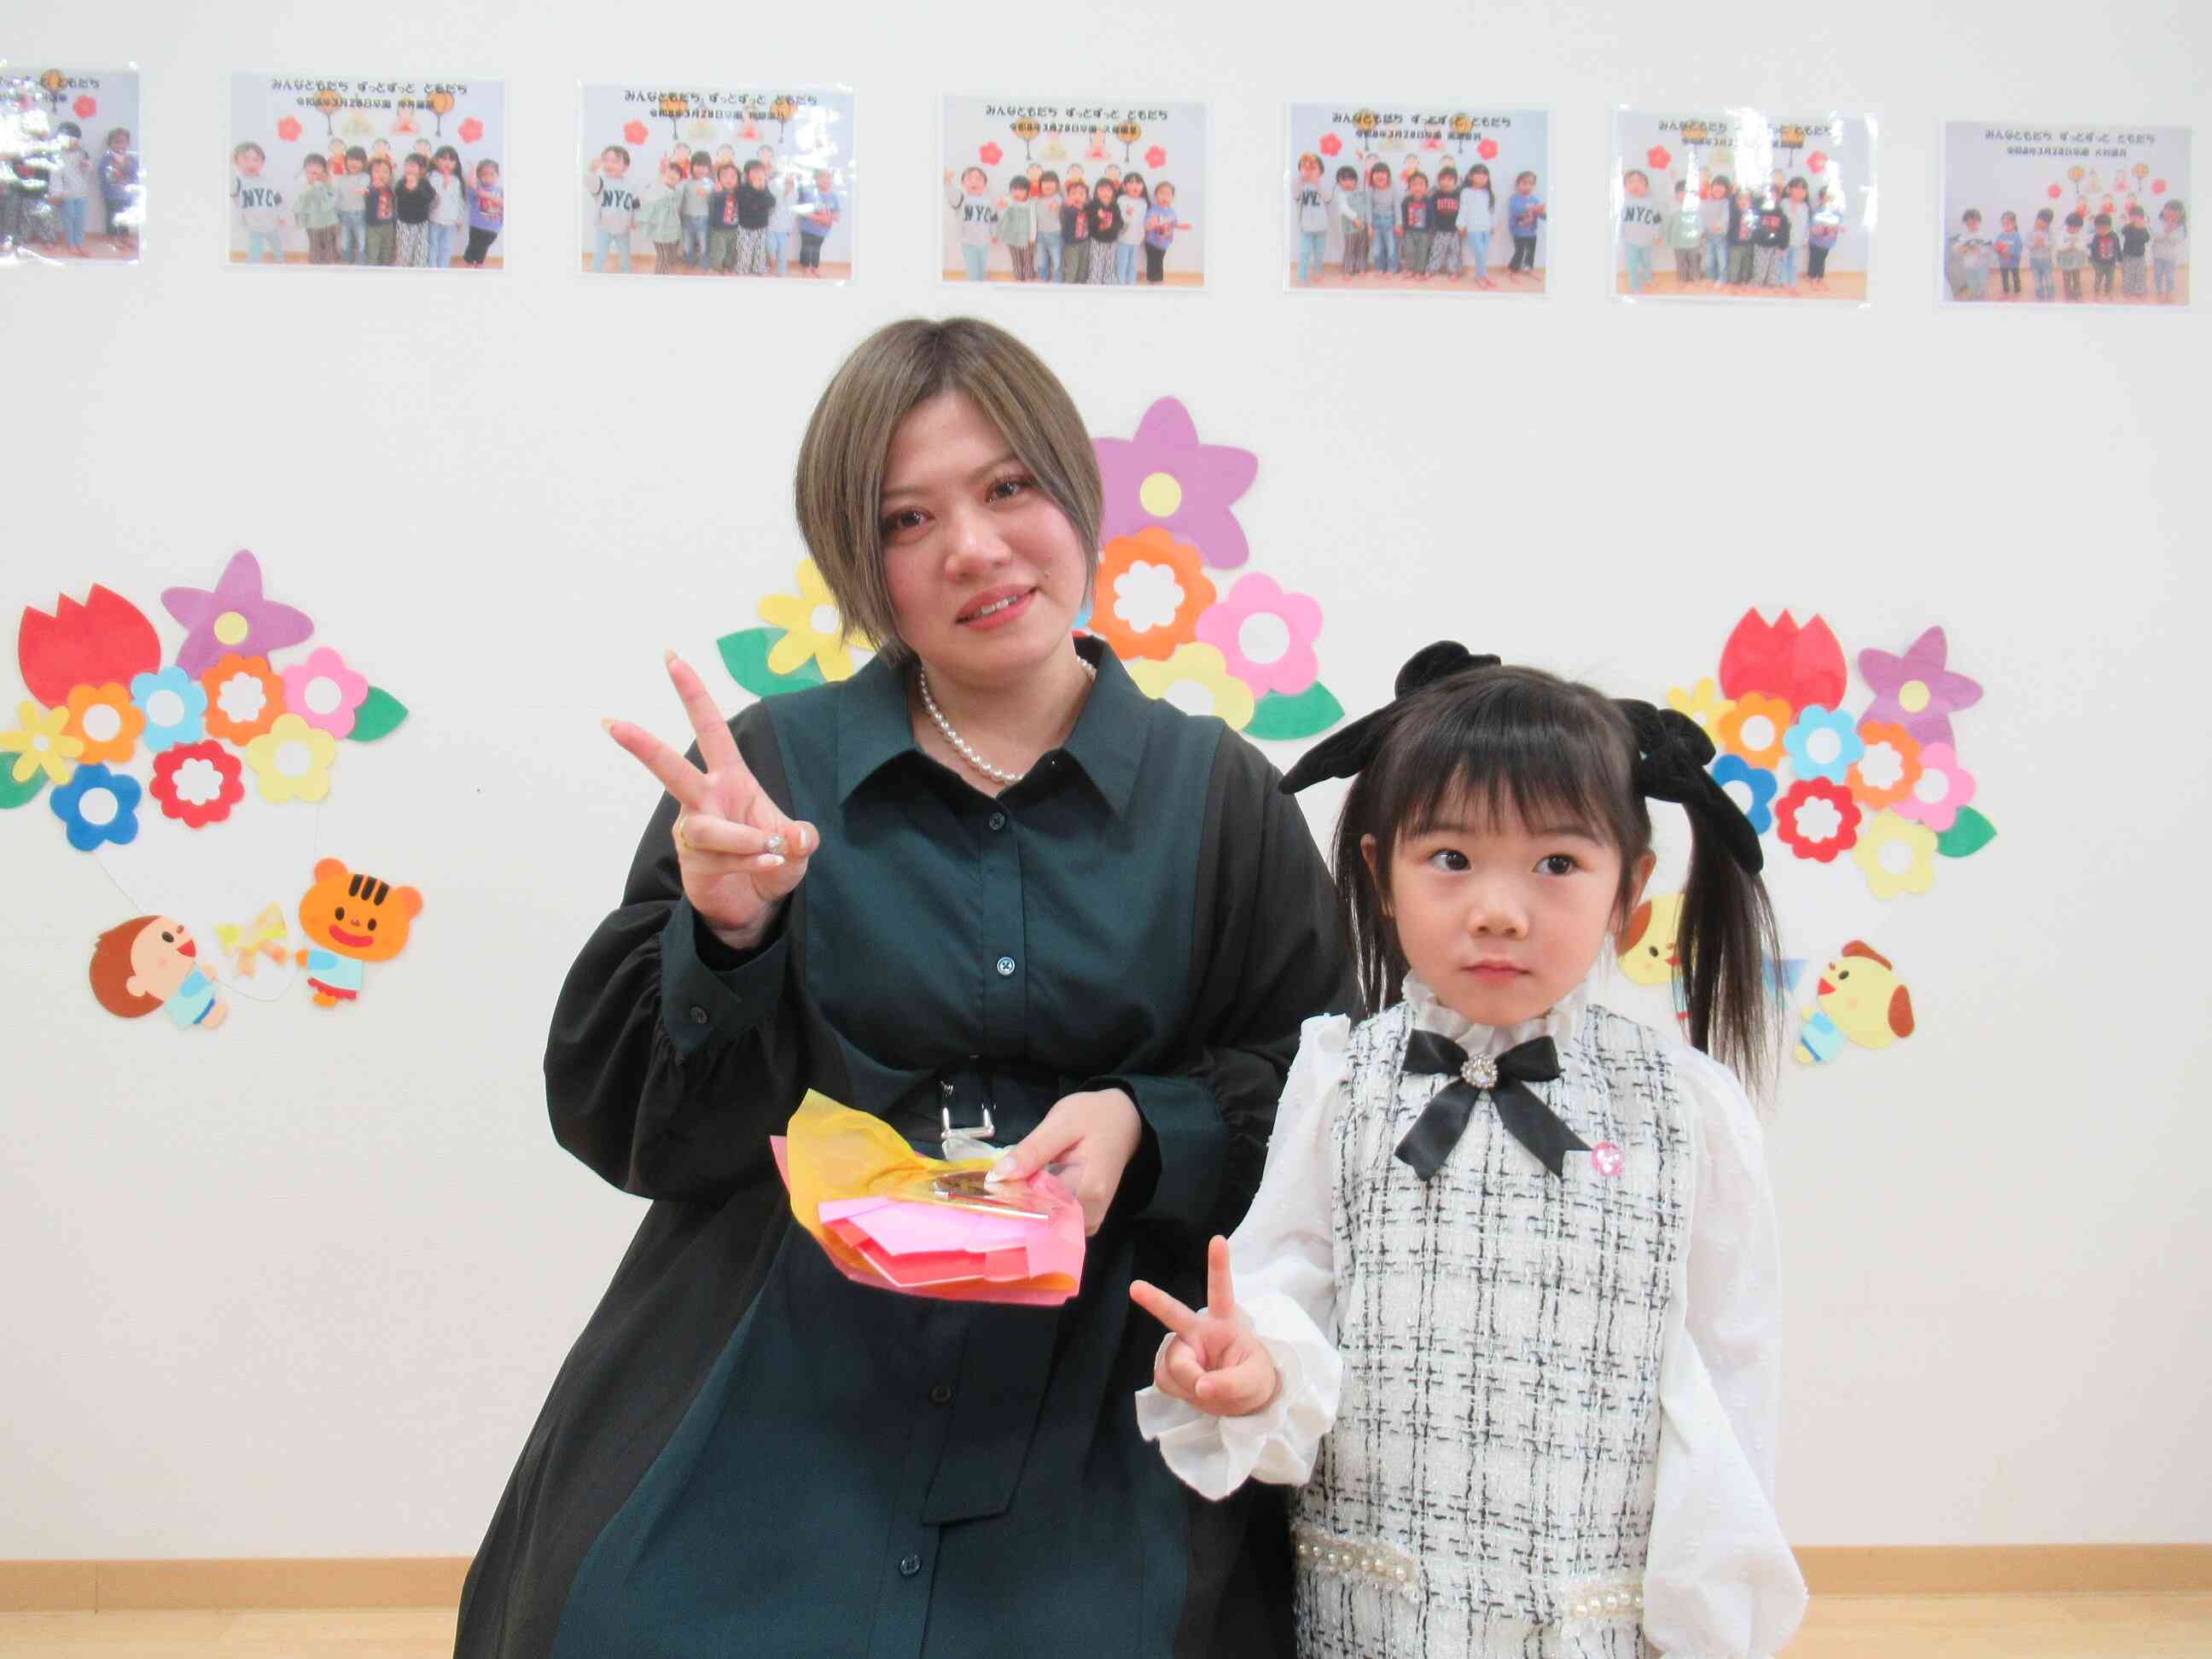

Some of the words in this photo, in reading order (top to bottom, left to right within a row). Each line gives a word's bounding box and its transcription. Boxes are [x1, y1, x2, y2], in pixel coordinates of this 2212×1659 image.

[271, 79, 348, 91] みんなともだち
[358, 81, 416, 93] ずっとずっと
[424, 83, 468, 95] ともだち
[625, 90, 700, 103] みんなともだち
[709, 92, 765, 105] ずっとずっと
[775, 95, 818, 106] ともだち
[986, 105, 1057, 118] みんなともだち
[1066, 107, 1120, 119] ずっとずっと
[1127, 109, 1168, 120] ともだち
[1332, 112, 1403, 124] みんなともだち
[1474, 116, 1511, 128] ともだち
[1659, 119, 1727, 134] みんなともだち
[1985, 130, 2052, 142] みんなともだち
[2059, 131, 2110, 143] ずっとずっと
[2116, 133, 2156, 144] ともだち
